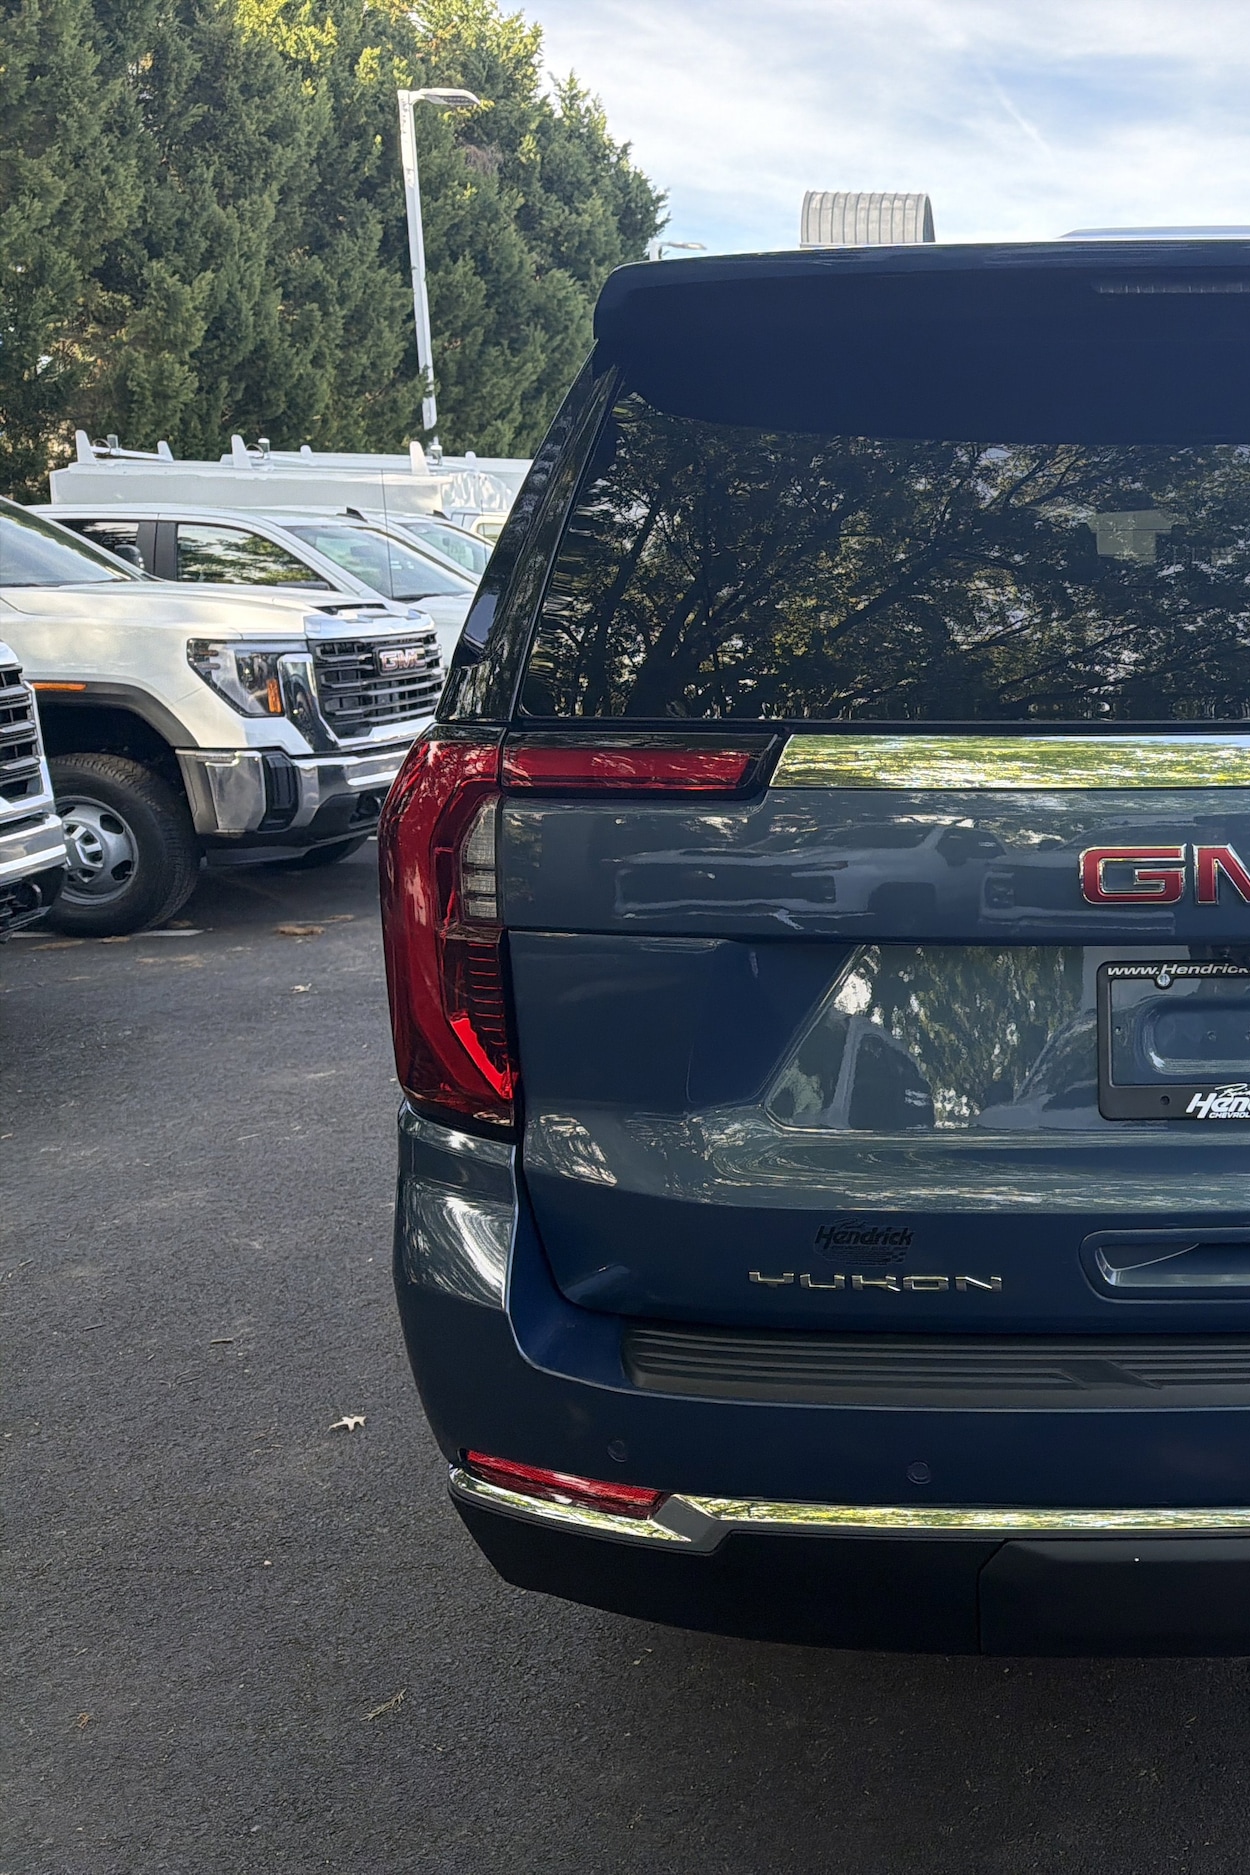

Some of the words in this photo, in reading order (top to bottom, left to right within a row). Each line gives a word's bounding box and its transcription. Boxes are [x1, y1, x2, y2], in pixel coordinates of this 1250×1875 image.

[379, 647, 426, 671] GMC
[815, 1225, 916, 1250] Hendrick
[748, 1271, 1003, 1293] YUKON
